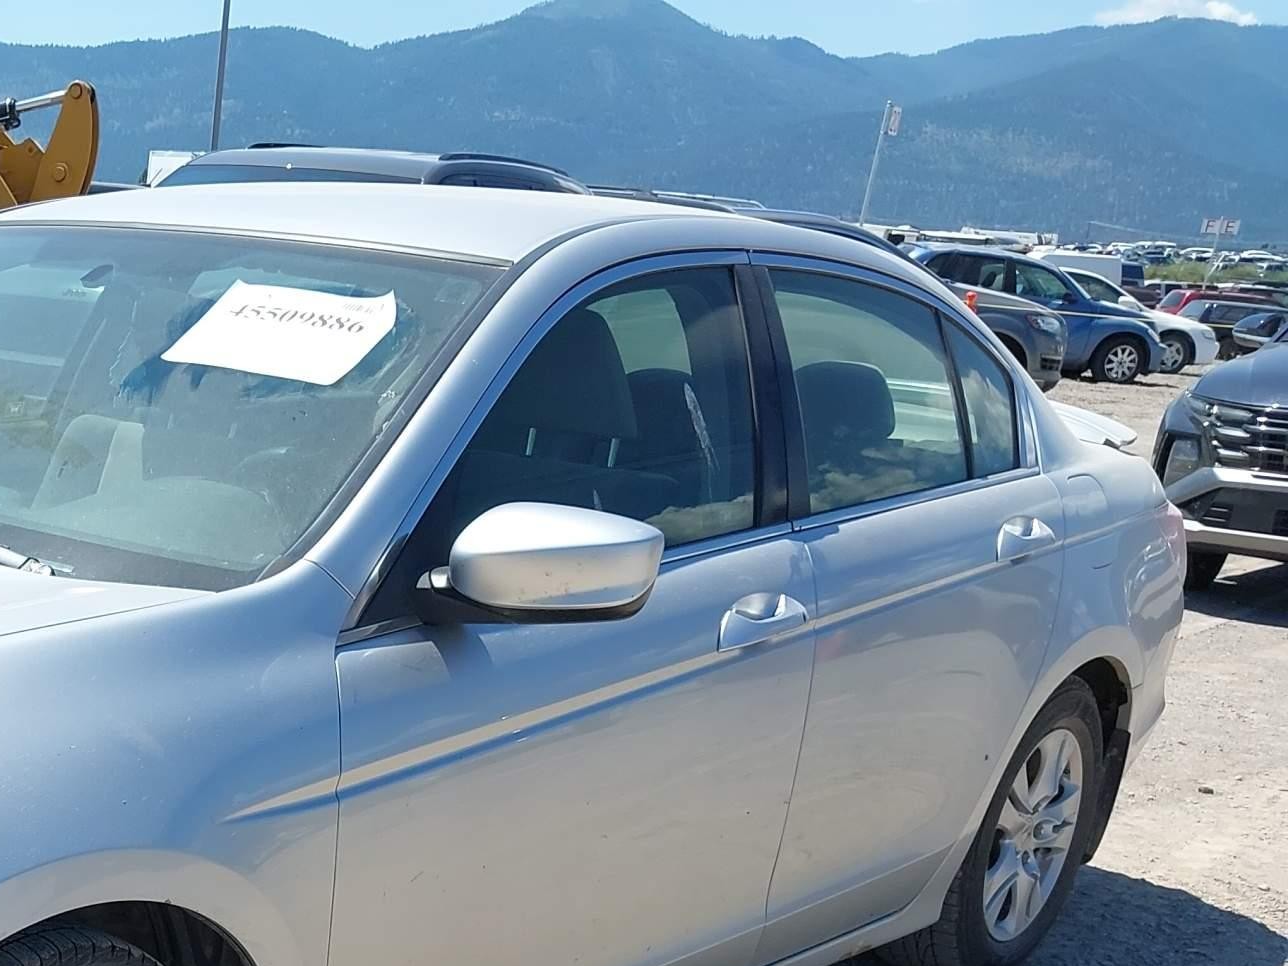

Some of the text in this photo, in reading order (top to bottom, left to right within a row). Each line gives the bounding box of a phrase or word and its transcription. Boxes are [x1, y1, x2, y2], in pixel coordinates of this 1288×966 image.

[1205, 220, 1216, 232] F
[1225, 220, 1236, 233] E
[230, 304, 365, 333] 45509886
